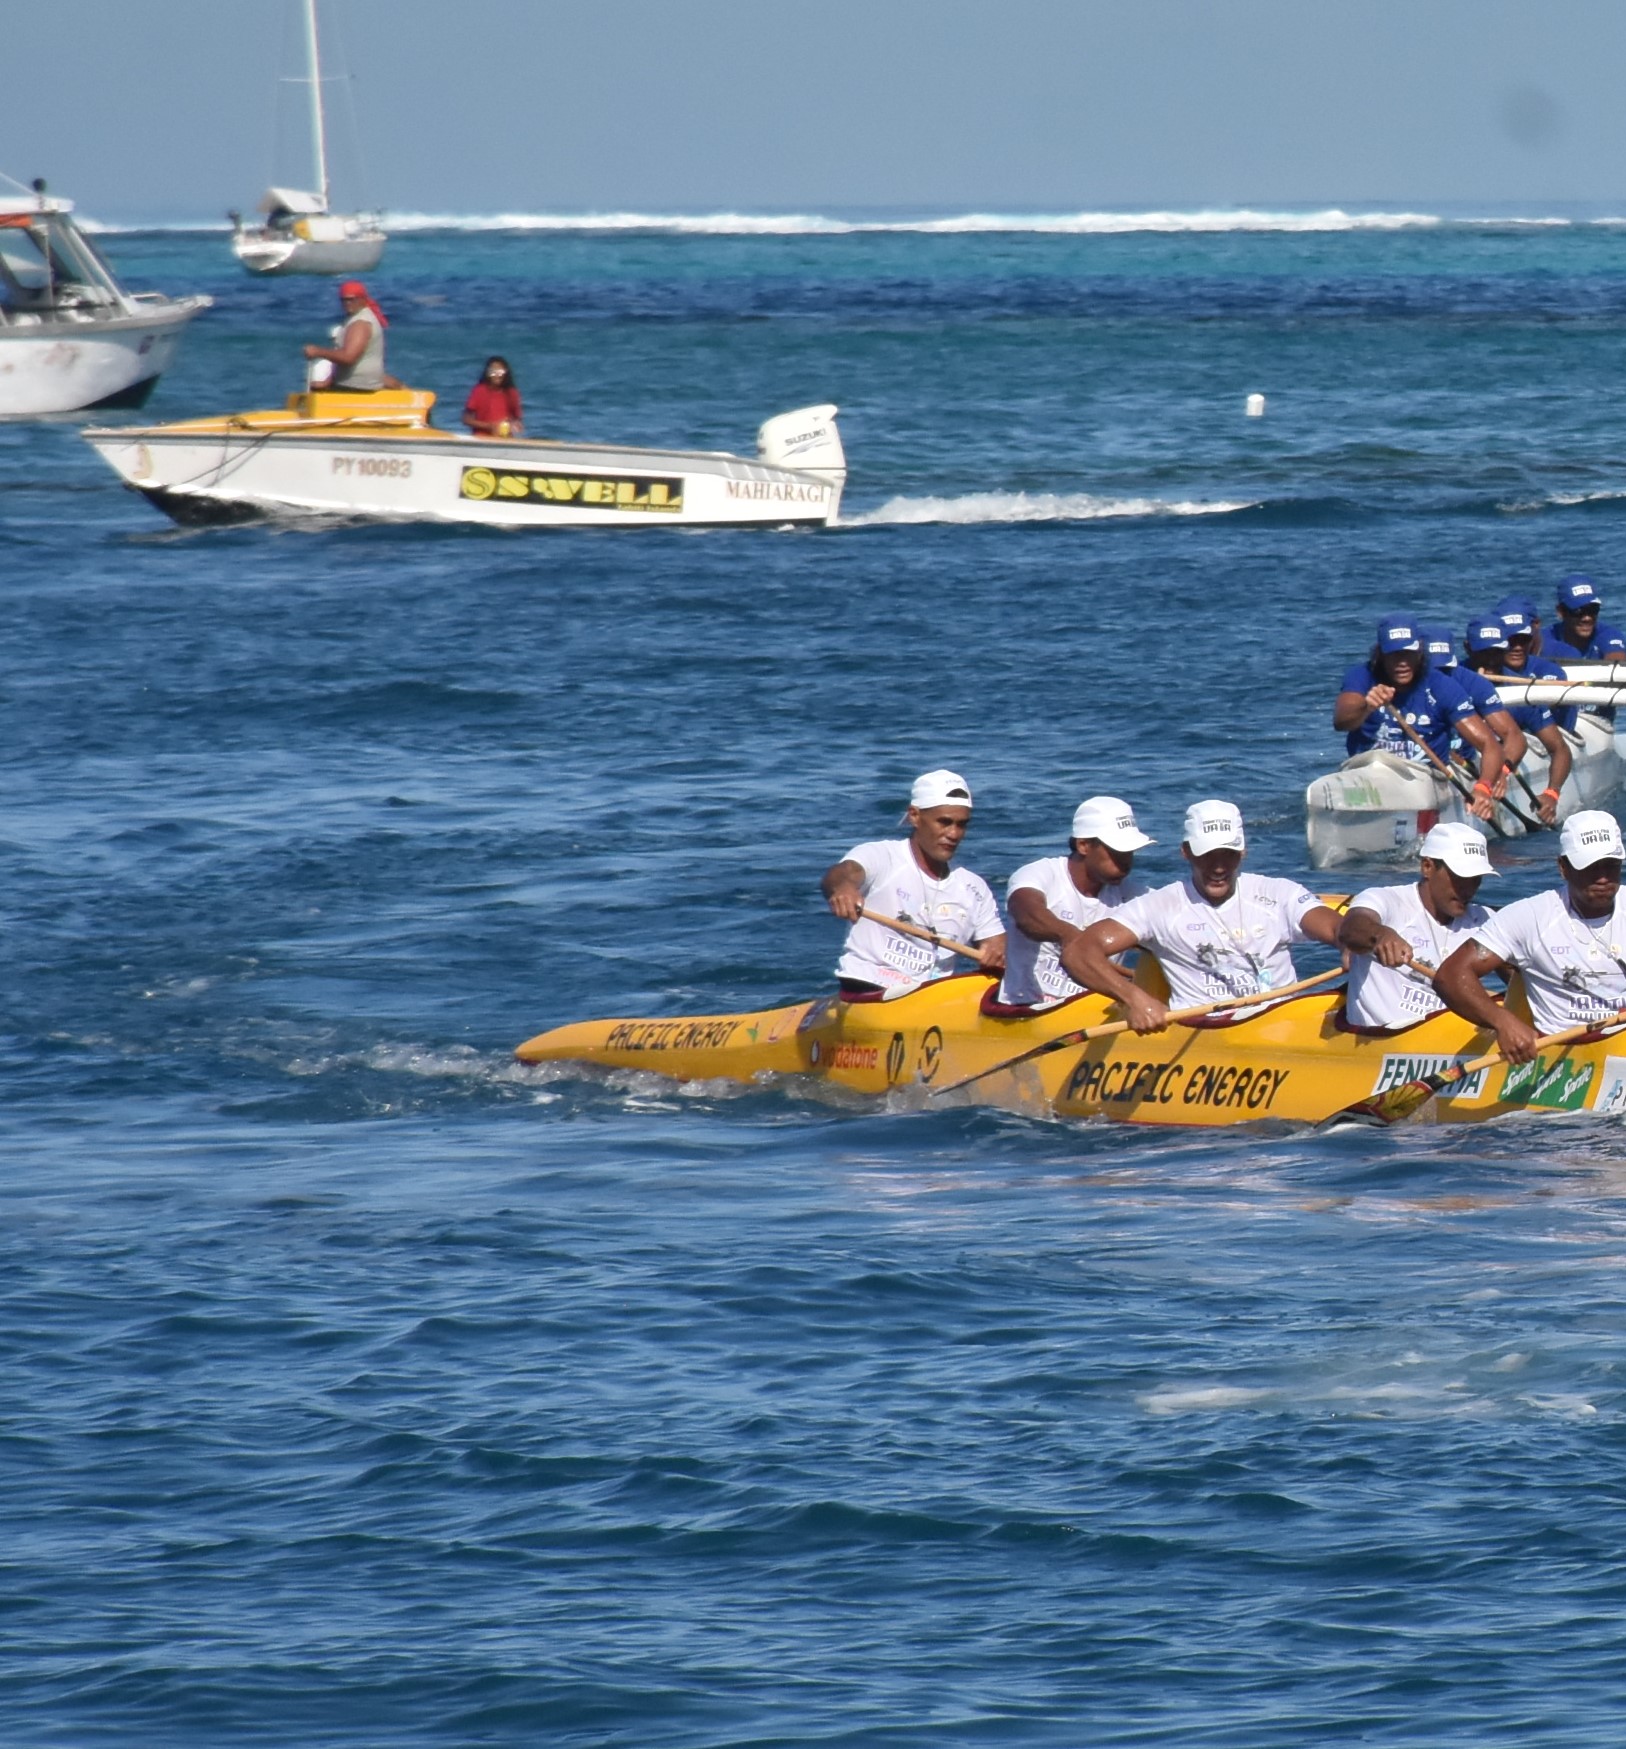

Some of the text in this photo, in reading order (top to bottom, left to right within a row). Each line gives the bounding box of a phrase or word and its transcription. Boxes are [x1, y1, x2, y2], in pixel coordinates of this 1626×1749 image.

[784, 428, 827, 446] SUZUKI
[332, 456, 356, 476] PY
[498, 474, 683, 506] SWELL
[727, 480, 826, 502] MAHIARAGI
[1551, 946, 1571, 954] EDT
[606, 1020, 745, 1050] PACIFIC ENERGY
[822, 1040, 878, 1069] vodafone
[1067, 1060, 1291, 1110] PACIFIC ENERGY
